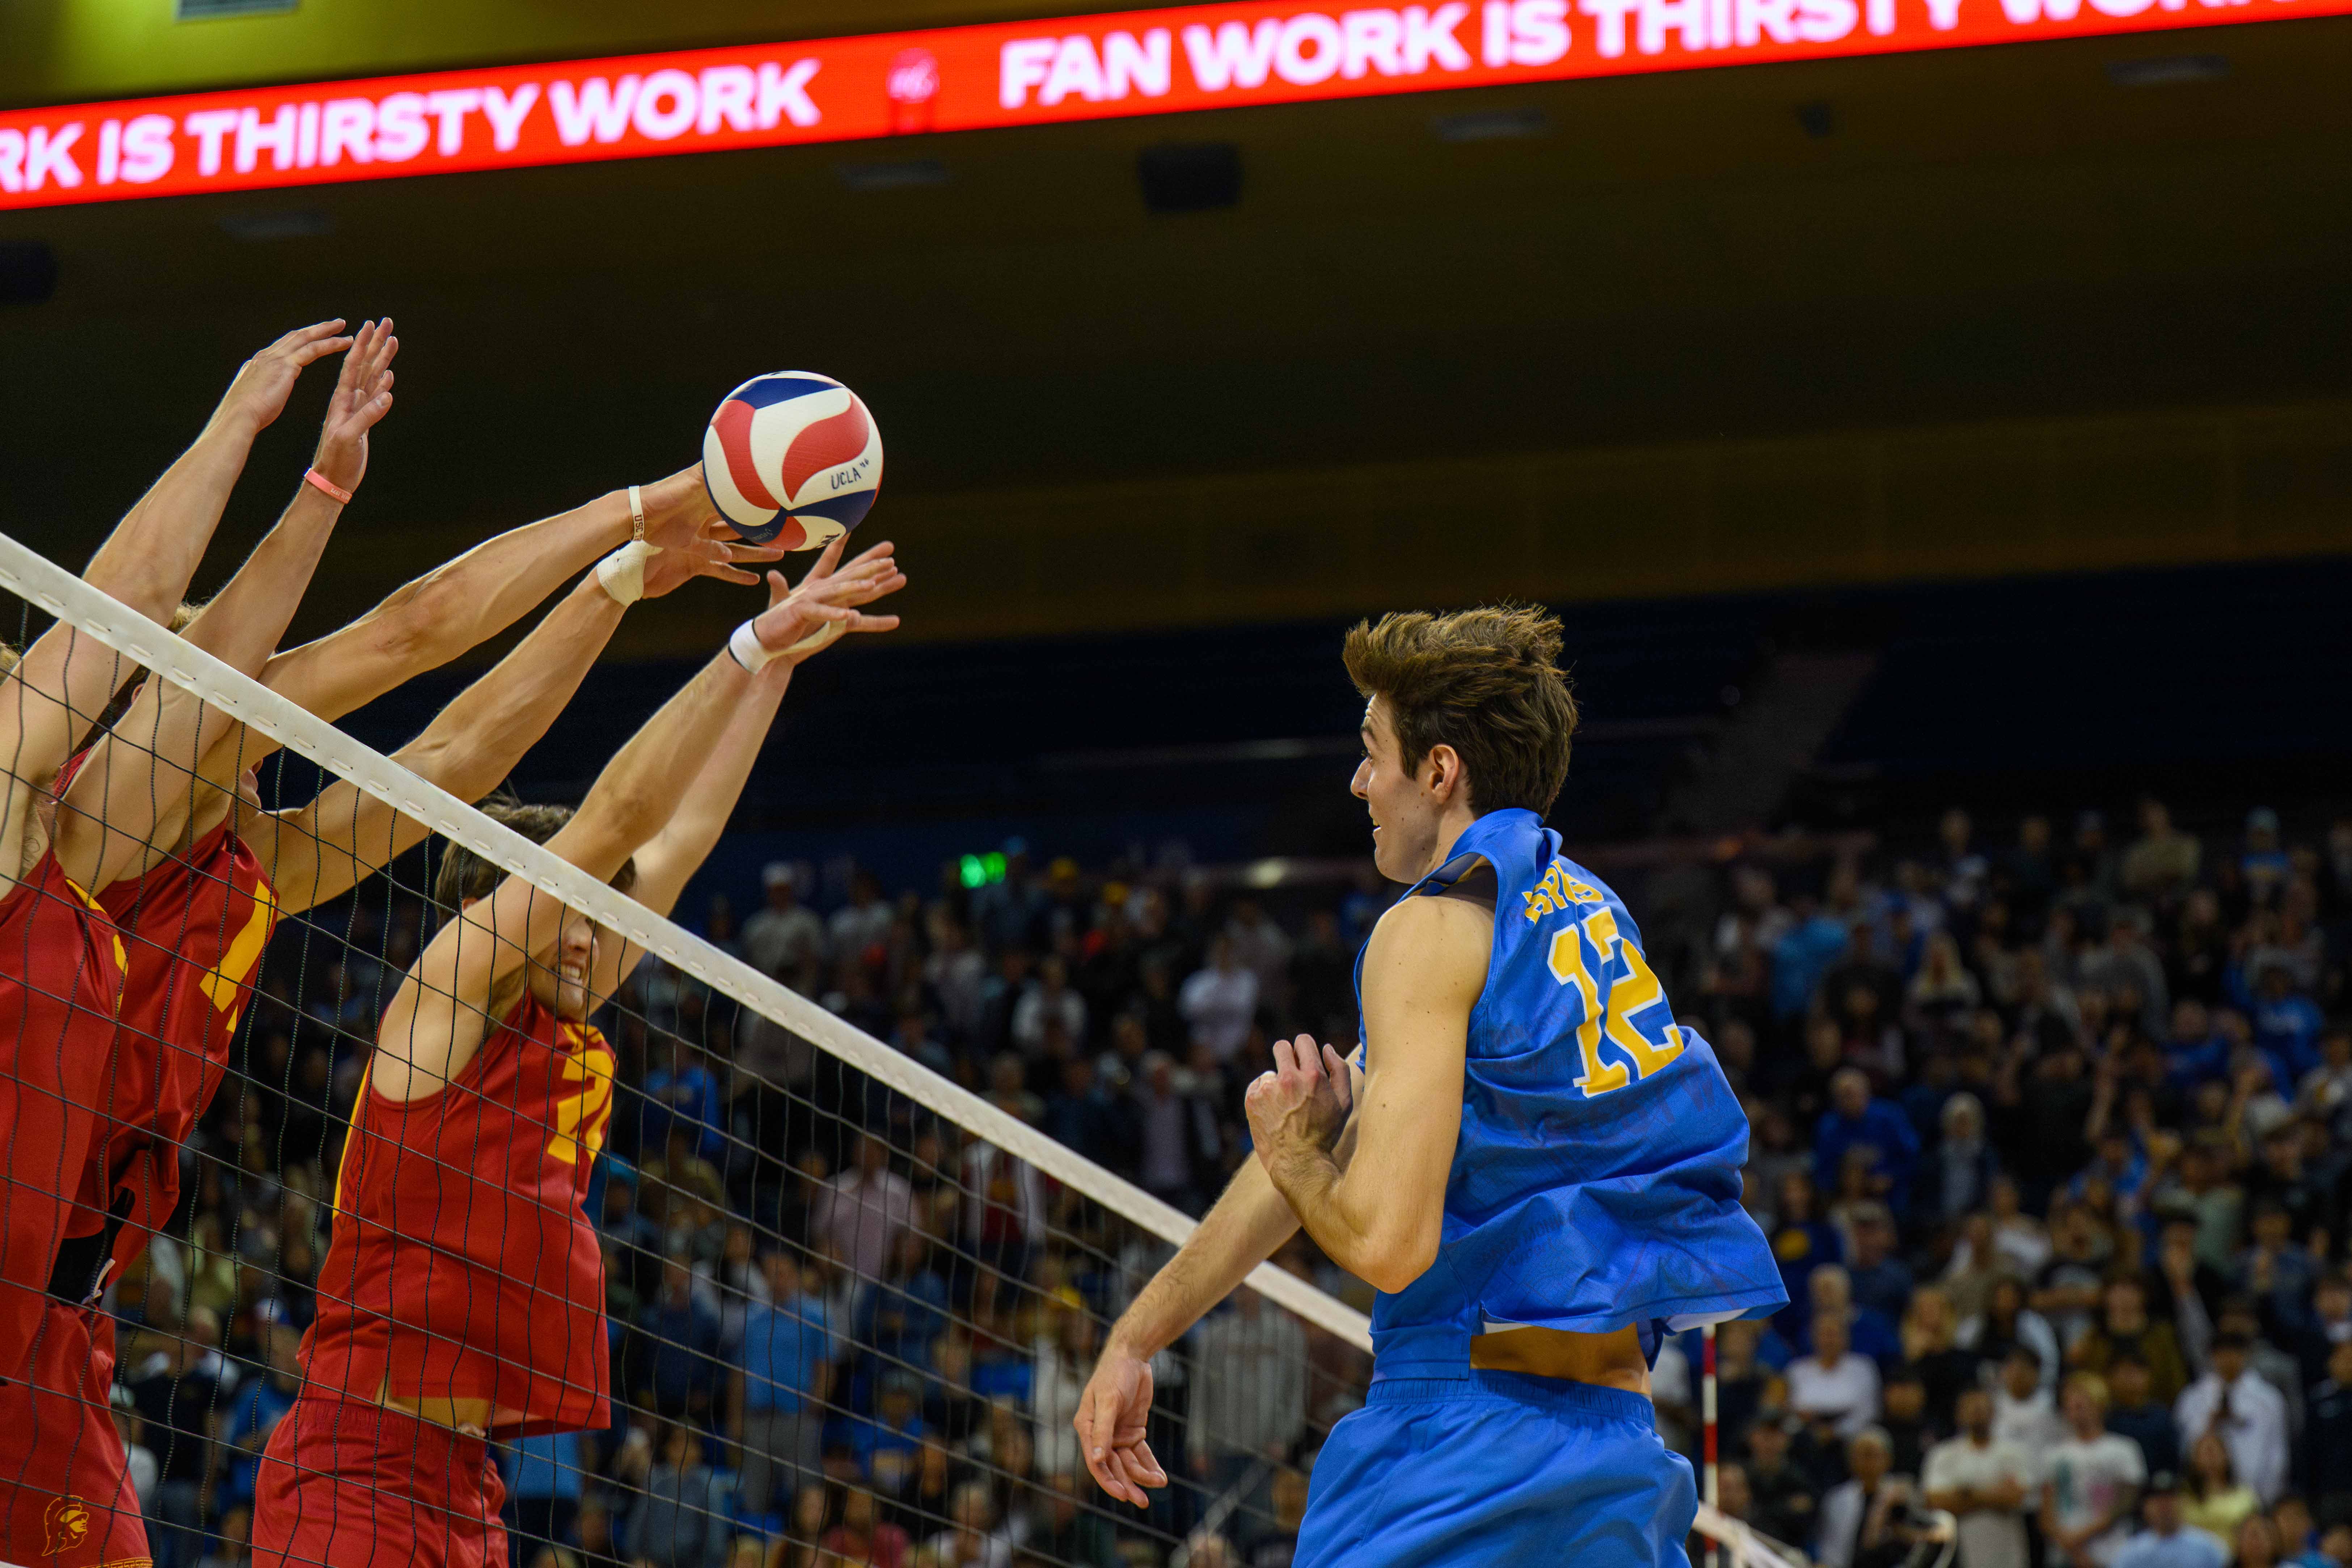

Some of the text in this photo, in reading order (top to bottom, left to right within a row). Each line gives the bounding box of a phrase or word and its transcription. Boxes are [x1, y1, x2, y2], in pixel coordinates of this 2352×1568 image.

[998, 27, 1173, 110] FAN
[1181, 1, 1471, 93] WORK
[1481, 0, 1573, 69] IS
[96, 113, 176, 185] IS
[184, 82, 541, 177] THIRSTY
[547, 58, 822, 147] WORK
[634, 514, 643, 532] USC
[831, 466, 861, 490] UCLA
[1547, 906, 1685, 1099] 12
